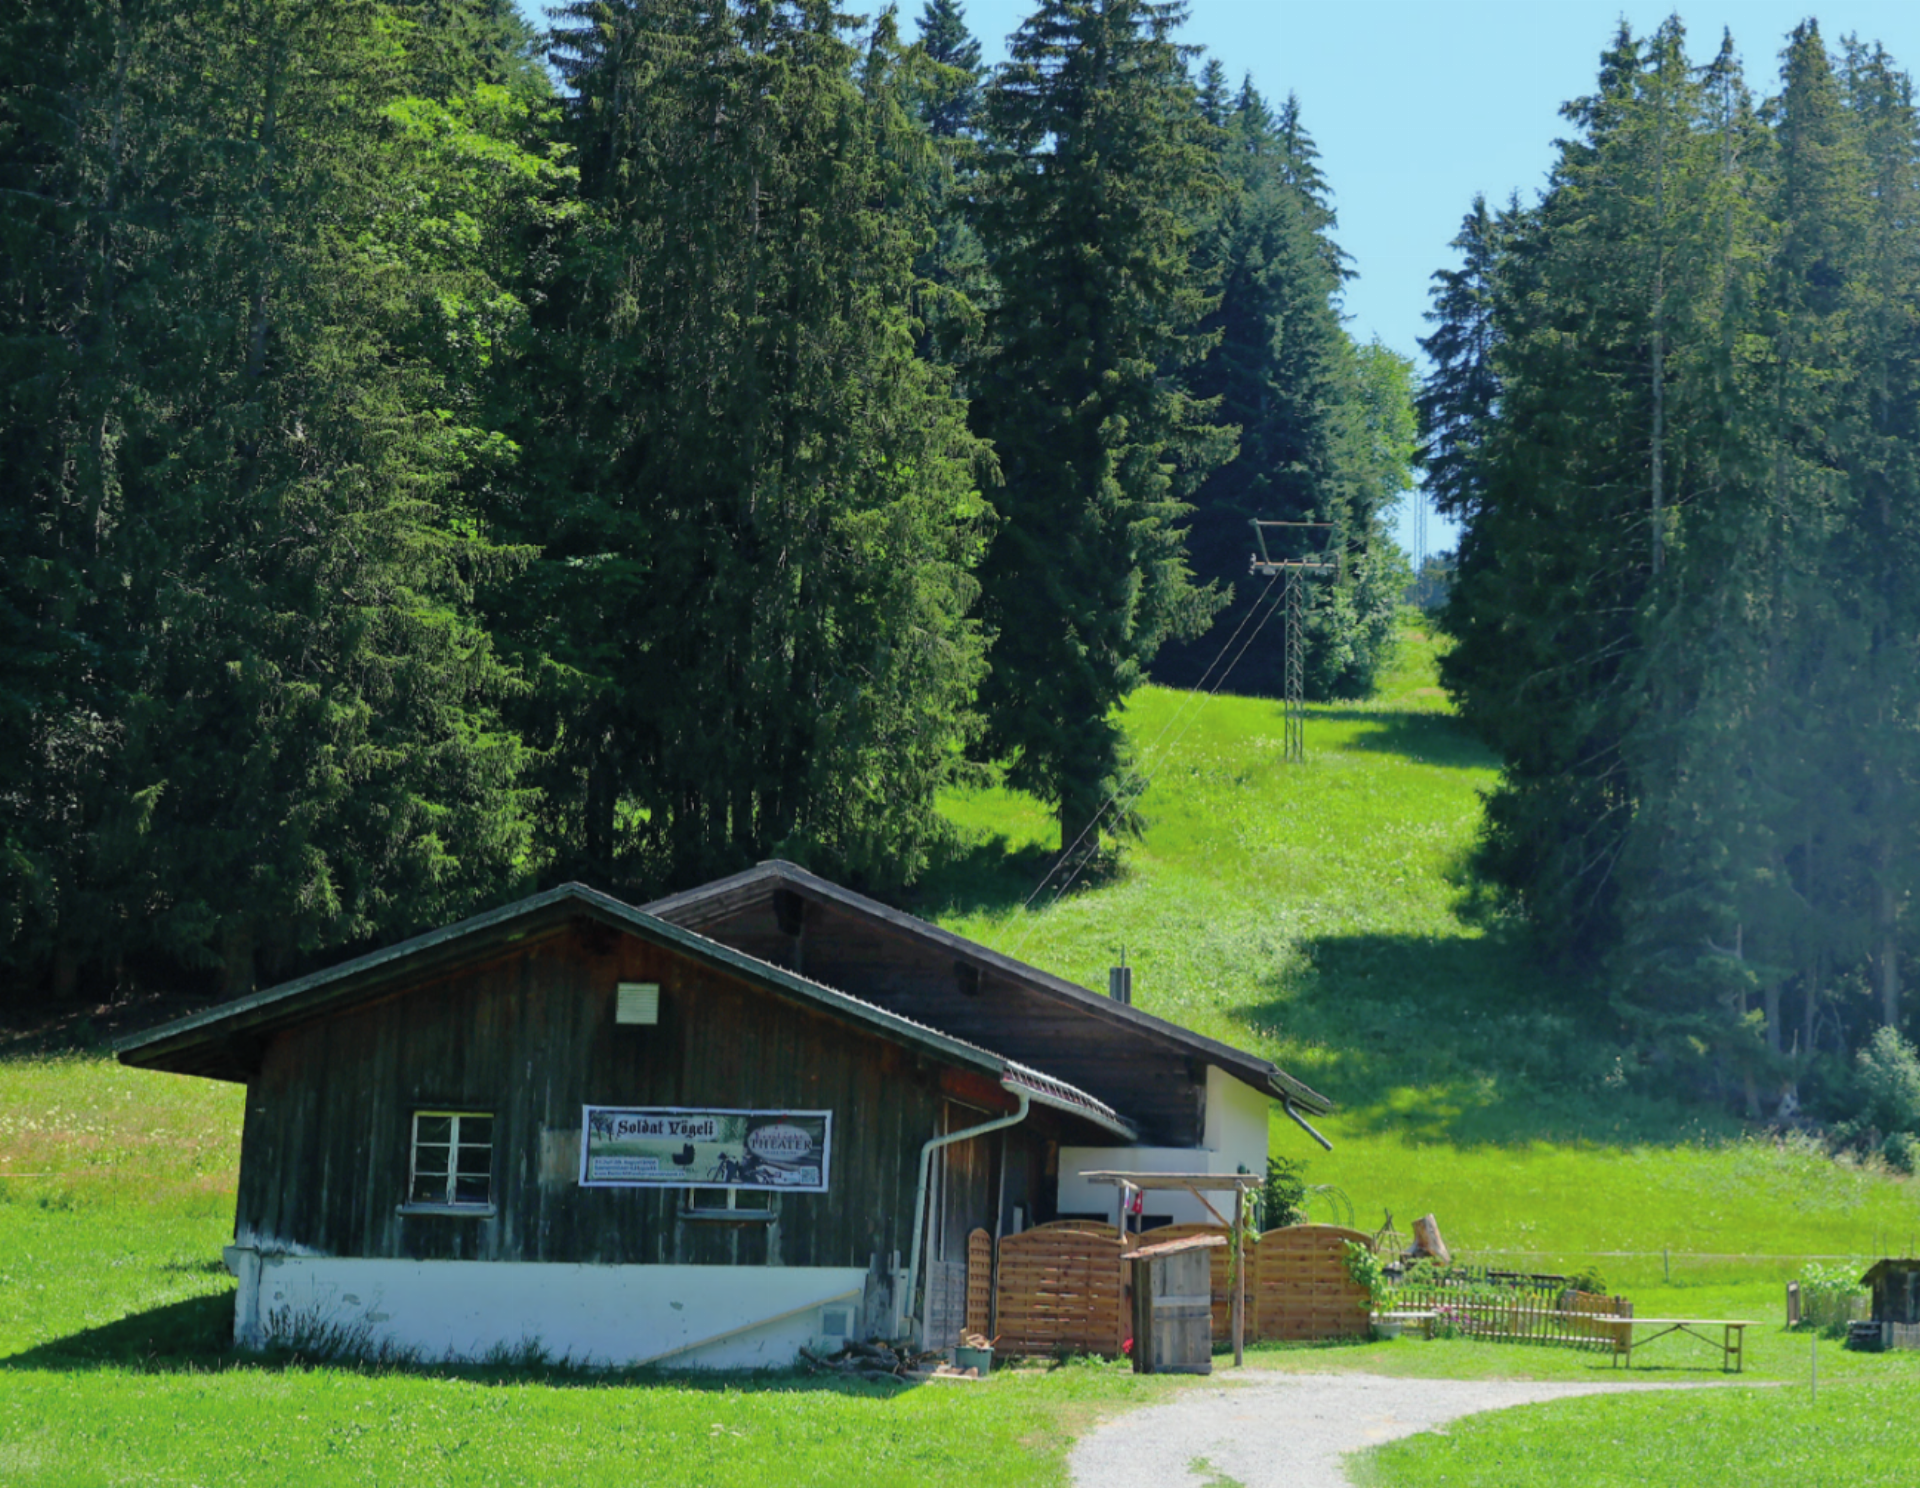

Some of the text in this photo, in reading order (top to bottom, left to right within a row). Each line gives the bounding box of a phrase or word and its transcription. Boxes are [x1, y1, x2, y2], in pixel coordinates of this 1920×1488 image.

[617, 1119, 714, 1139] Soldat Vögeli
[751, 1139, 813, 1151] THEATER
